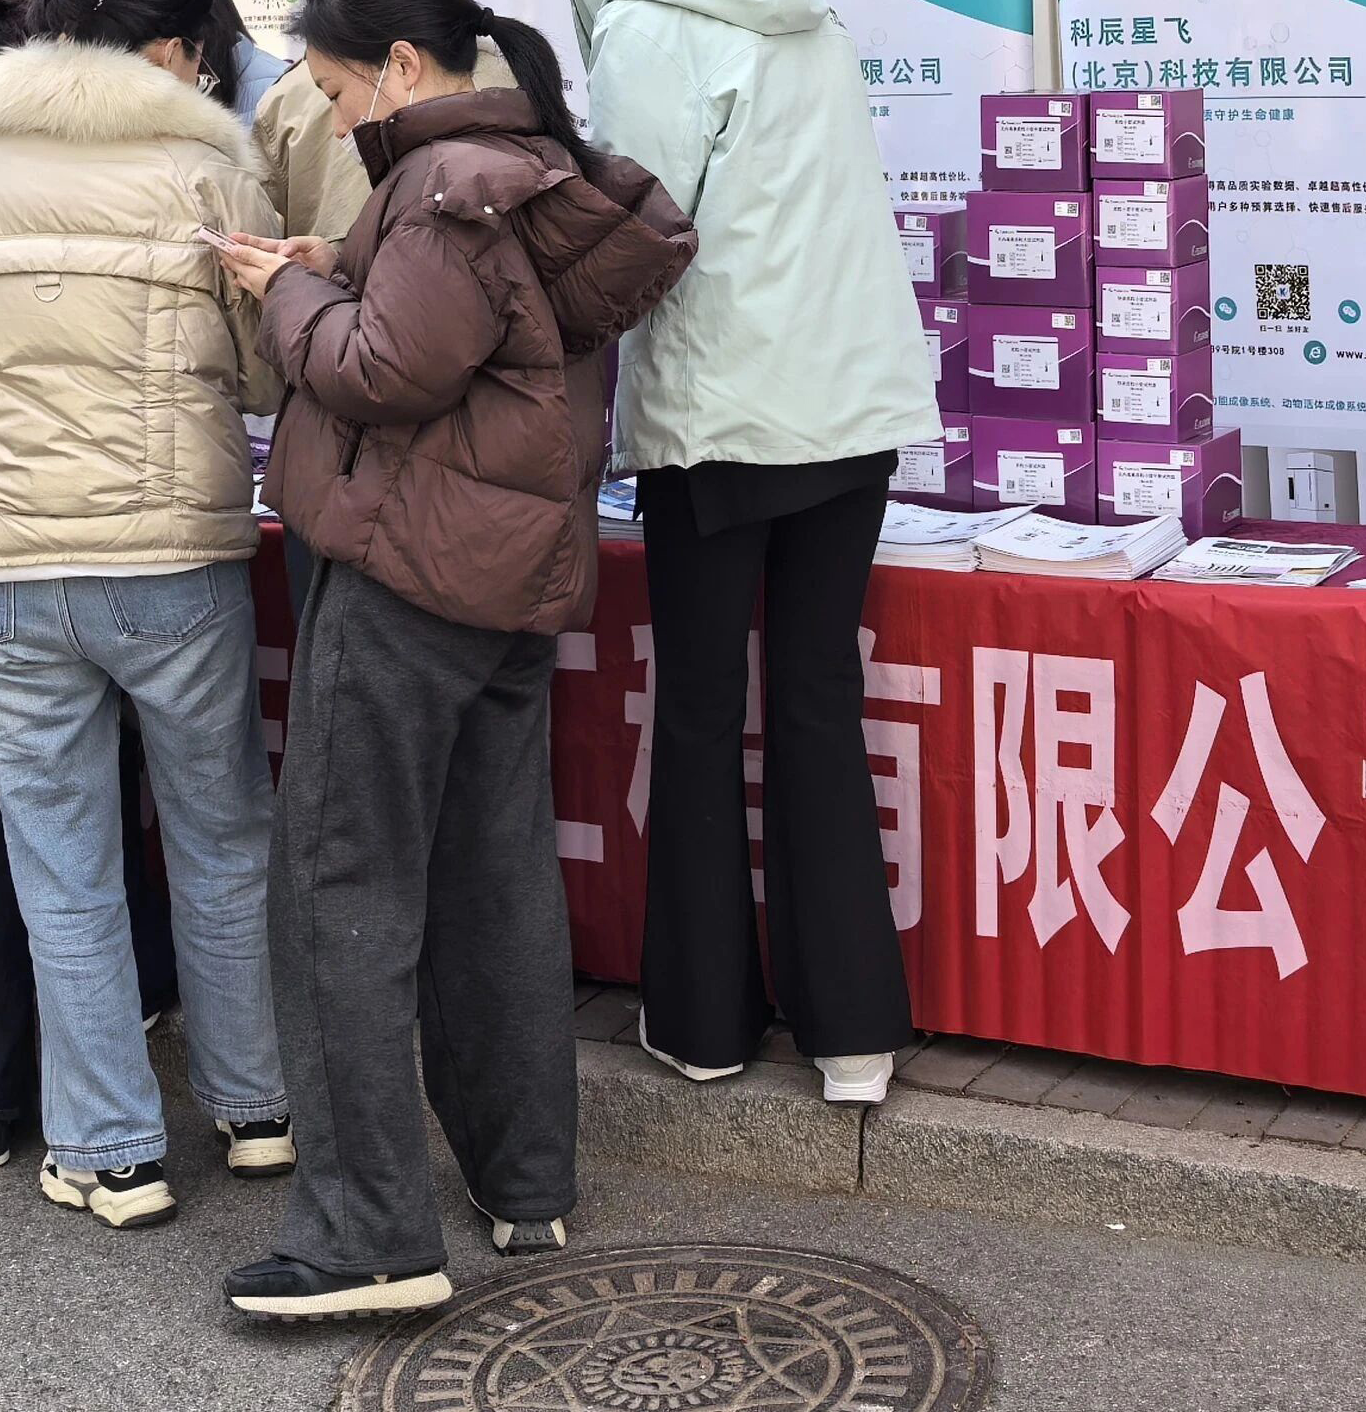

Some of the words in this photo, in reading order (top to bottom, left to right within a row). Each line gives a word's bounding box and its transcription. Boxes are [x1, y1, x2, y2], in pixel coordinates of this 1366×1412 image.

[1070, 16, 1194, 48] 科辰星飞
[1071, 55, 1354, 89] (北京)科技有限公司
